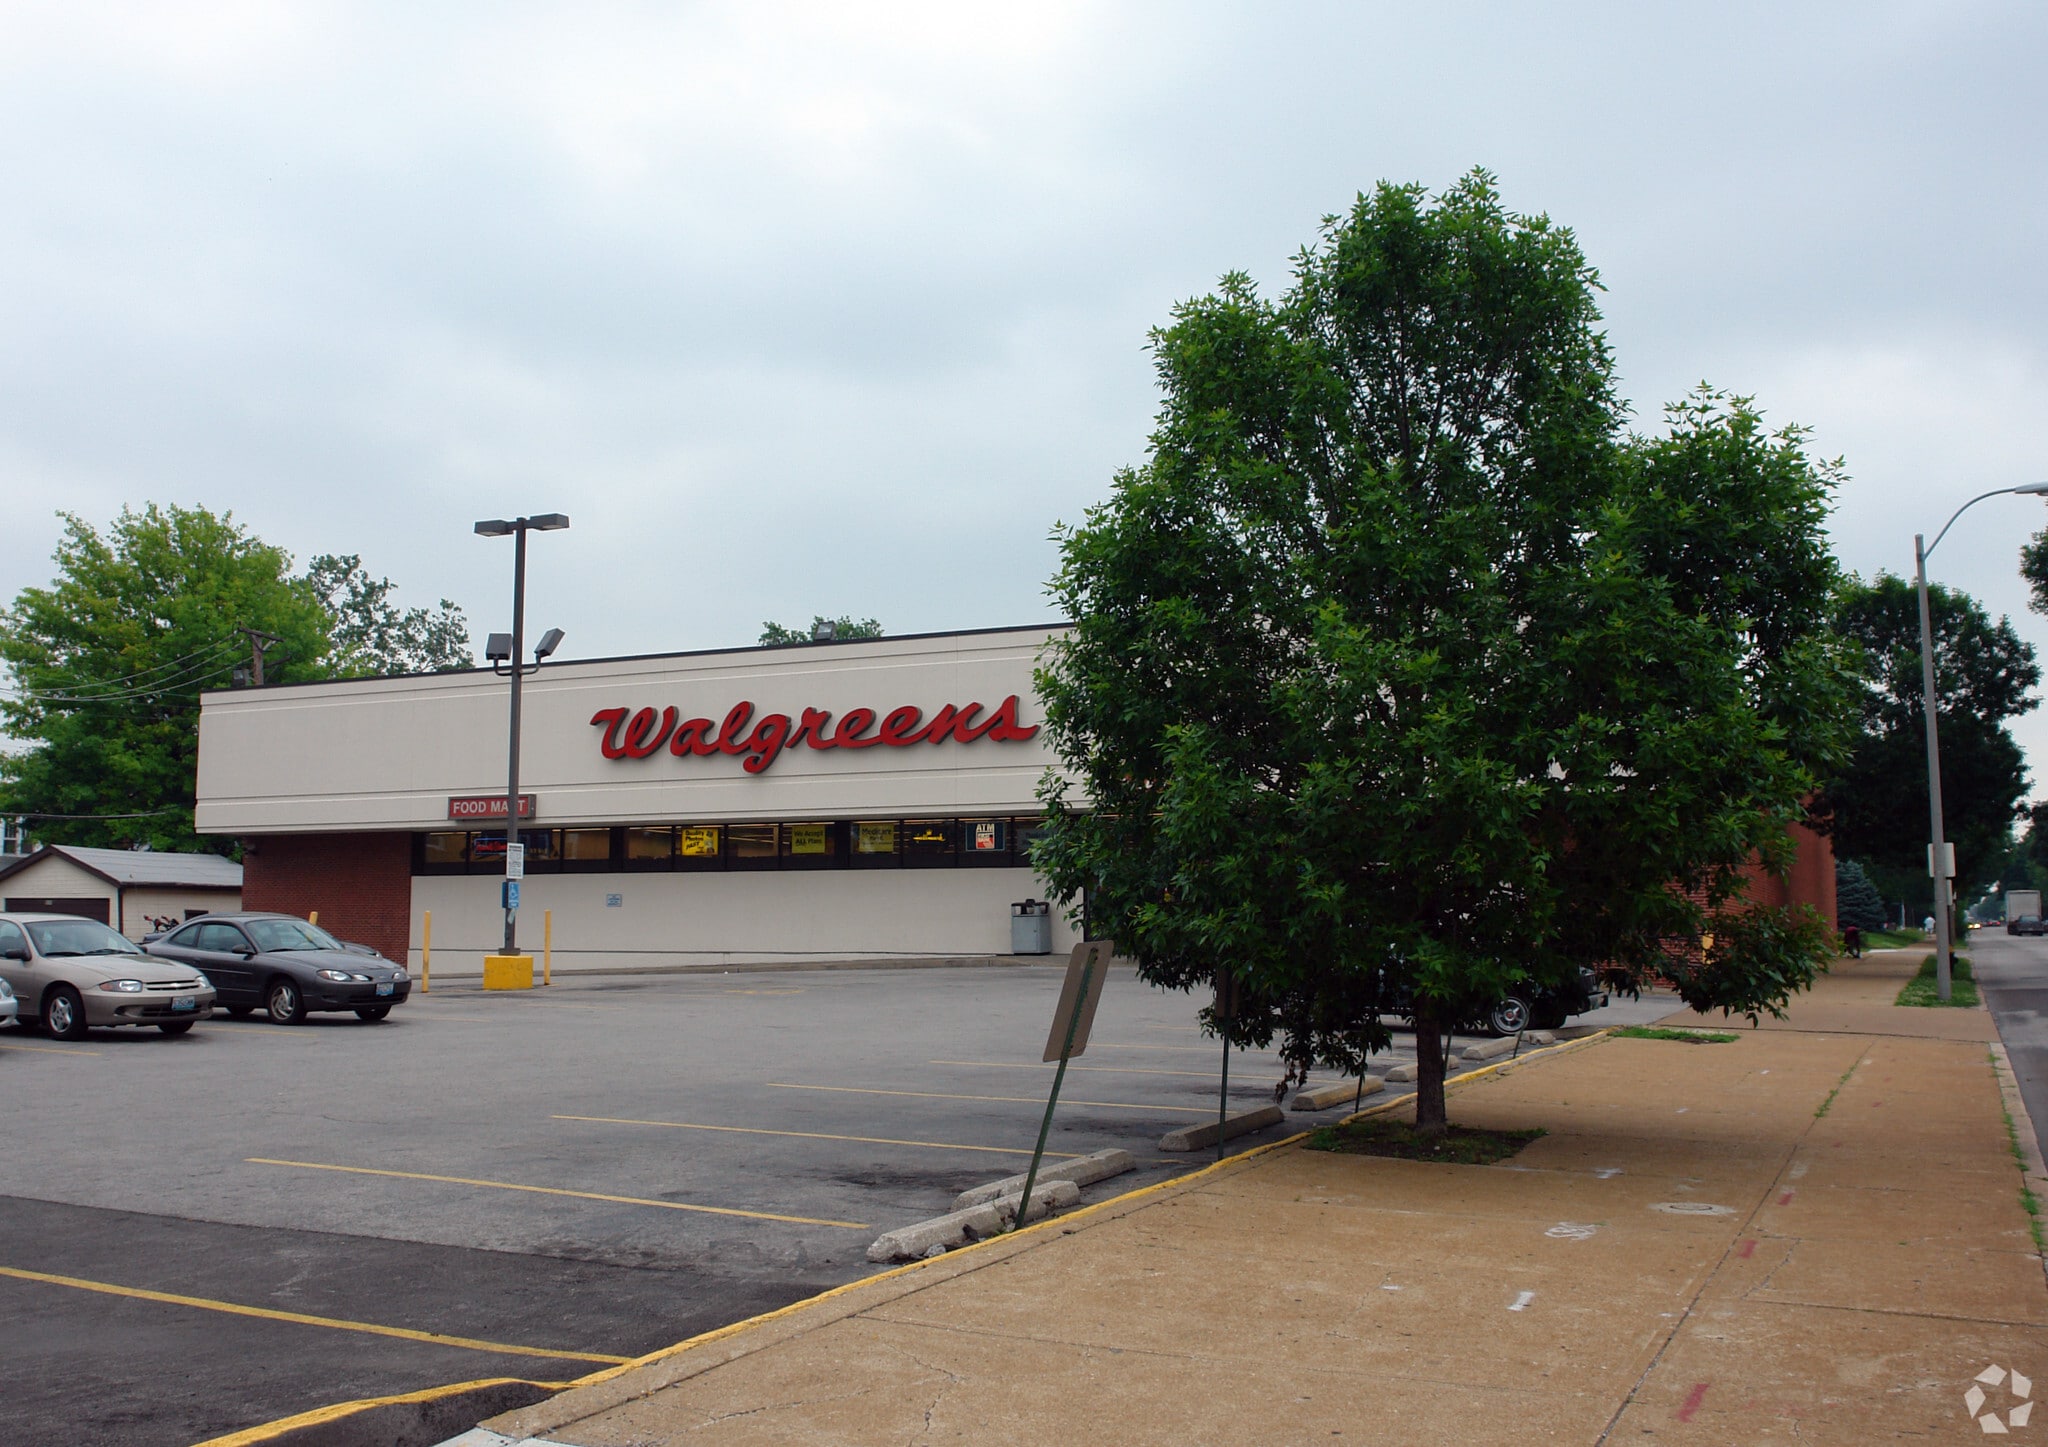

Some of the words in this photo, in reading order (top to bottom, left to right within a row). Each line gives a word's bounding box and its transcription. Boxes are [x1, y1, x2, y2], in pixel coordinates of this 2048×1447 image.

[590, 694, 1041, 775] Walgreens
[453, 801, 487, 814] FOOD
[490, 800, 526, 813] MAT
[976, 823, 995, 832] ATM
